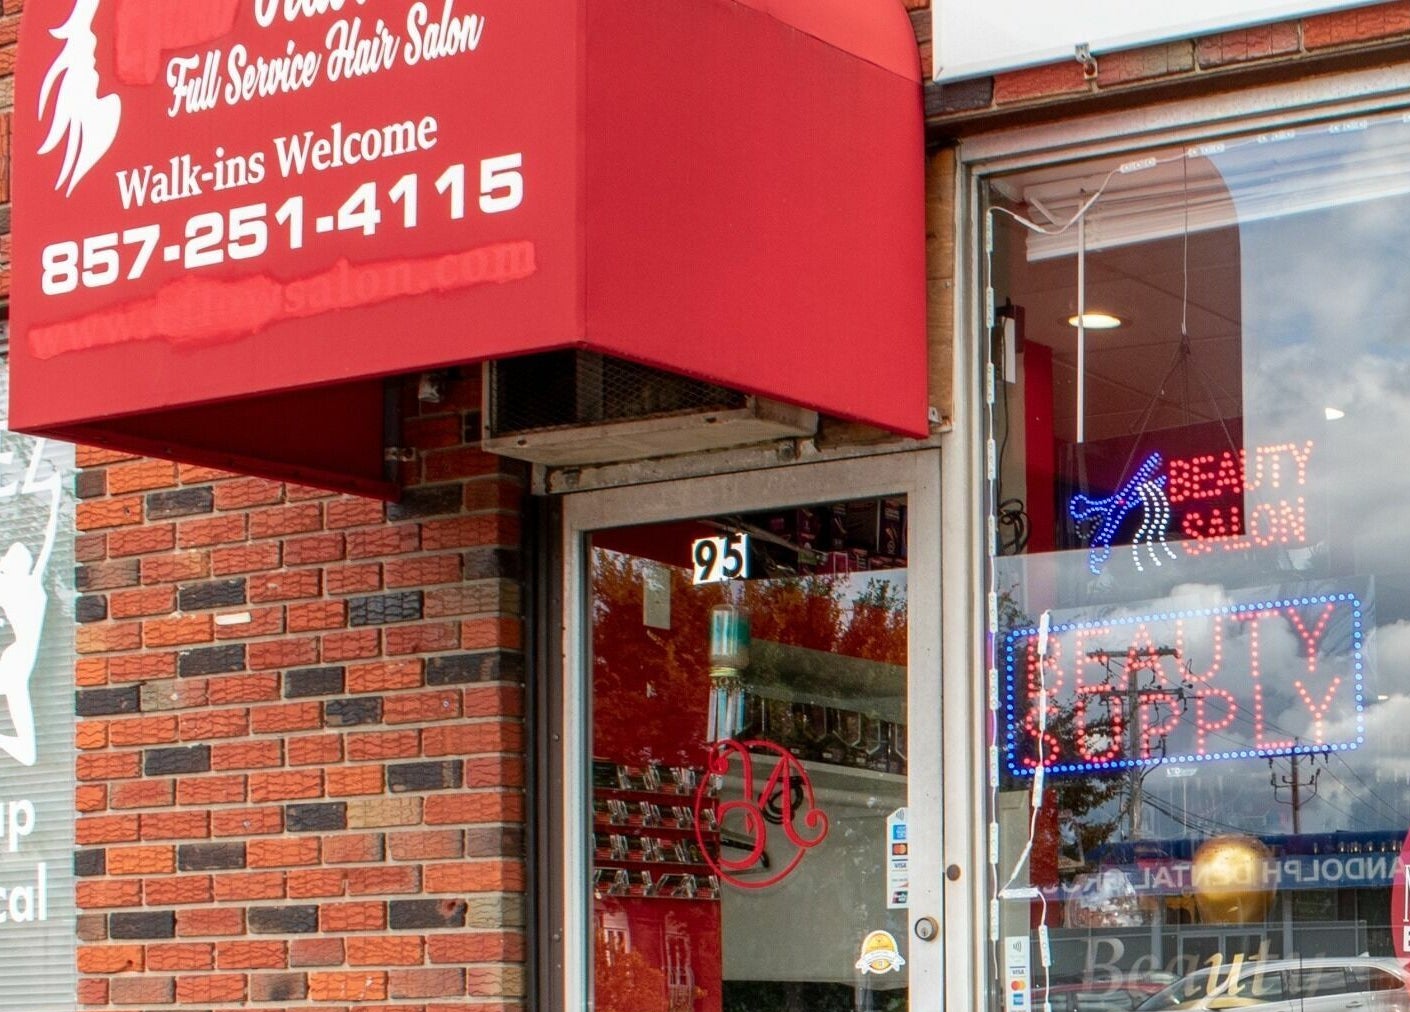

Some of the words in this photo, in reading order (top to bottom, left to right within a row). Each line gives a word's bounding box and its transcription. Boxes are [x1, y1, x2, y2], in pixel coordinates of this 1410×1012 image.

[166, 49, 222, 118] Full
[224, 40, 322, 106] Service
[325, 17, 401, 82] Hair
[404, 0, 485, 66] Salon
[116, 147, 265, 210] Walk-ins
[273, 115, 438, 178] Welcome
[40, 152, 524, 296] 857-251-4115
[1169, 440, 1313, 503] BEAUTY
[695, 536, 743, 581] 95
[1181, 497, 1305, 557] SALON
[1026, 602, 1336, 698] BEAUTY
[1021, 676, 1340, 767] SUPPLY
[0, 799, 36, 853] p
